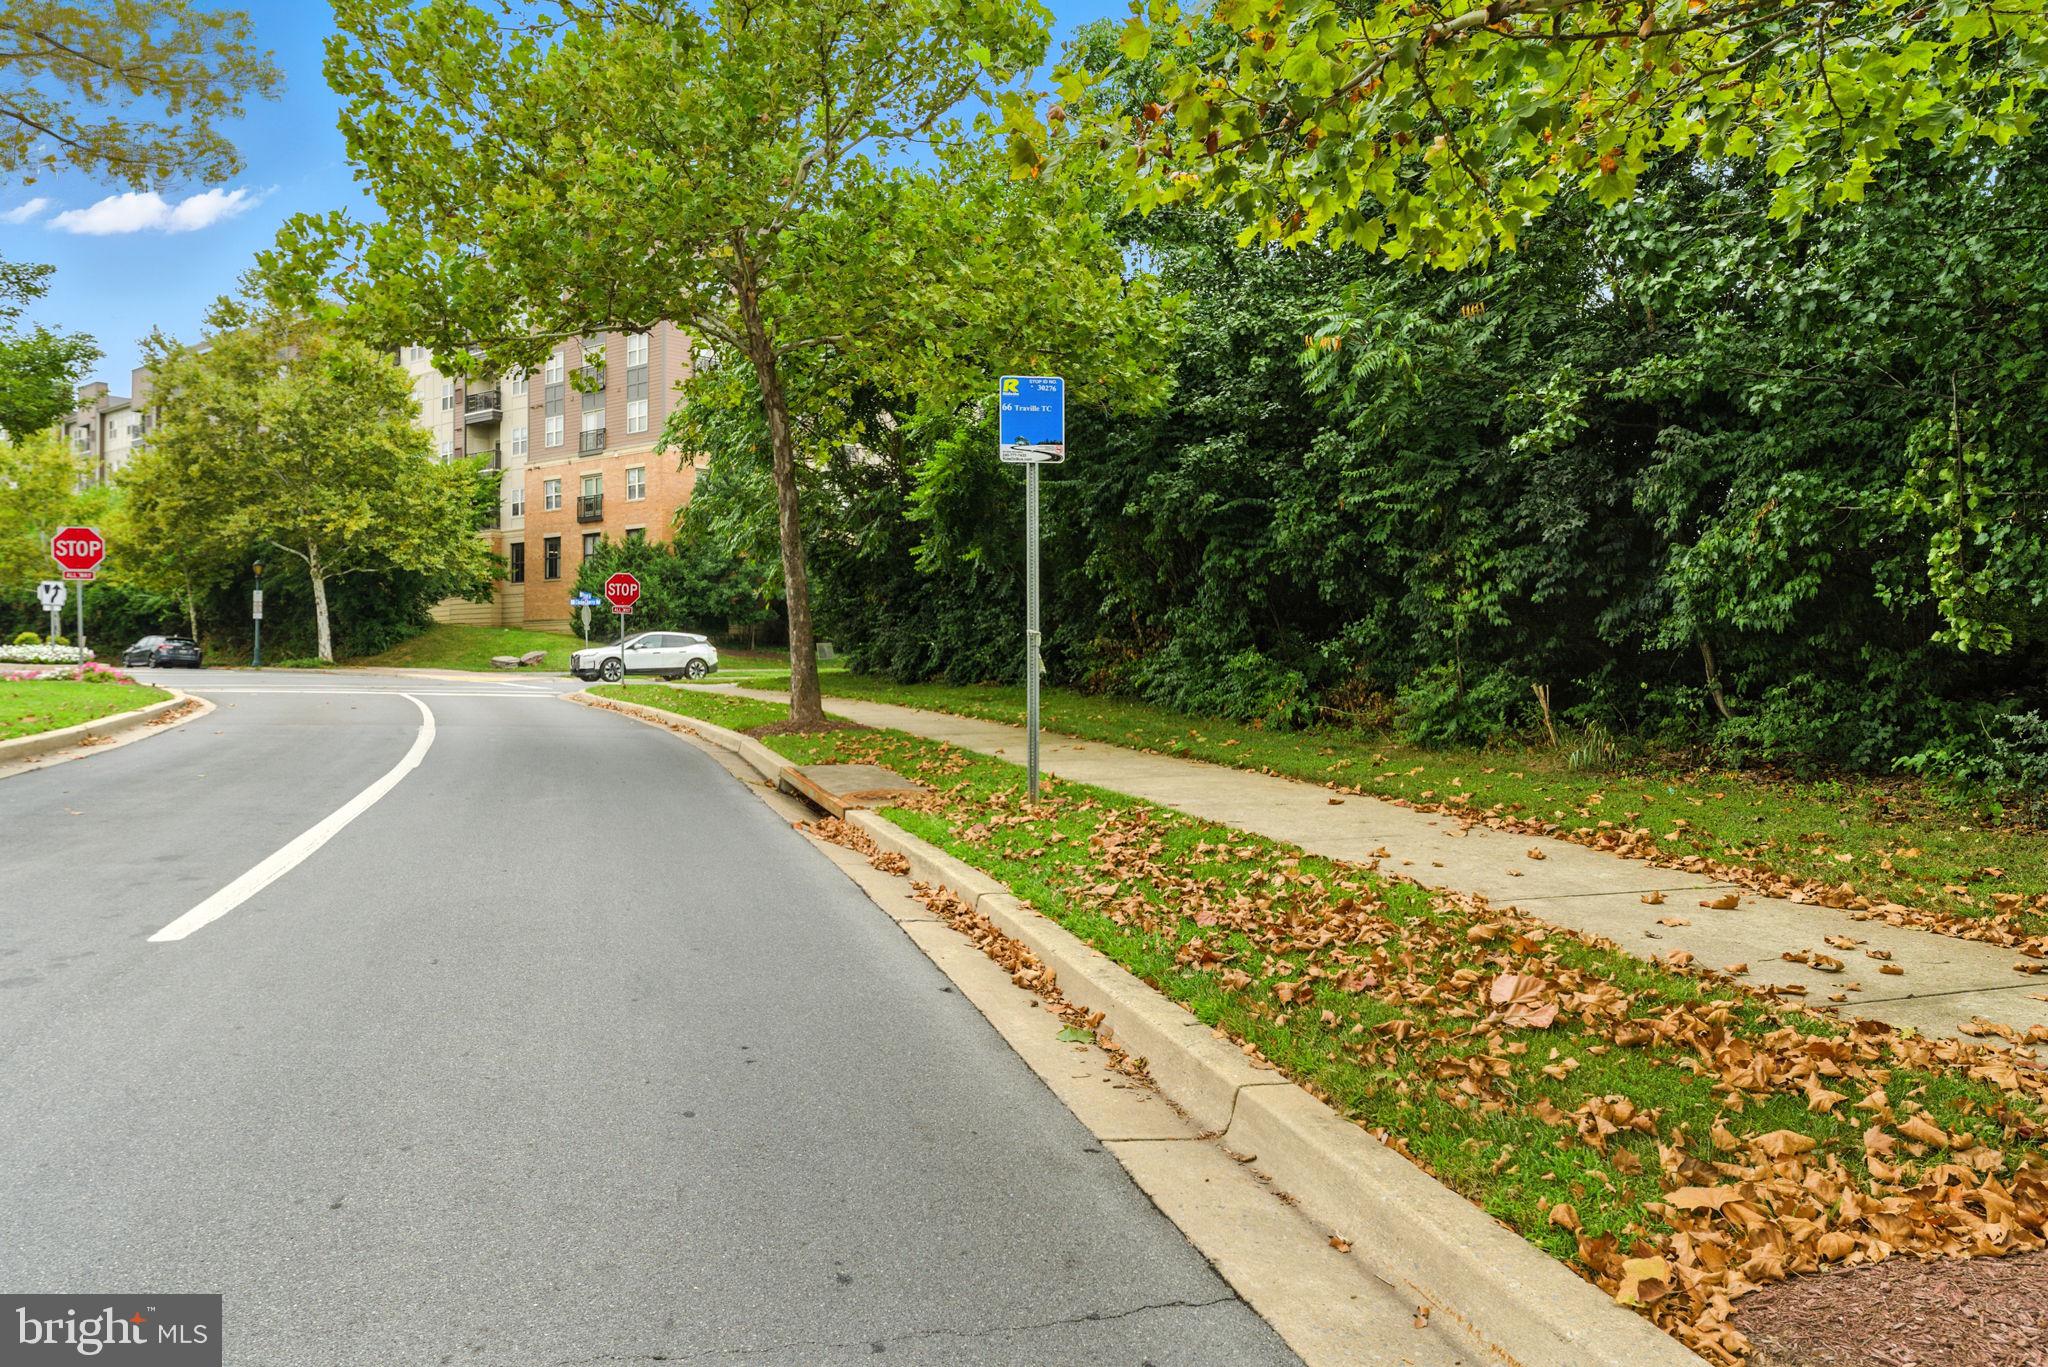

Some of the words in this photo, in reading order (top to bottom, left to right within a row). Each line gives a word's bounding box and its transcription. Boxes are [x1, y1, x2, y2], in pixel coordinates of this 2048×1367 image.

[1037, 384, 1056, 392] 30276
[1002, 403, 1012, 411] 66
[1041, 405, 1052, 413] TC
[55, 540, 101, 557] STOP
[608, 583, 637, 596] STOP
